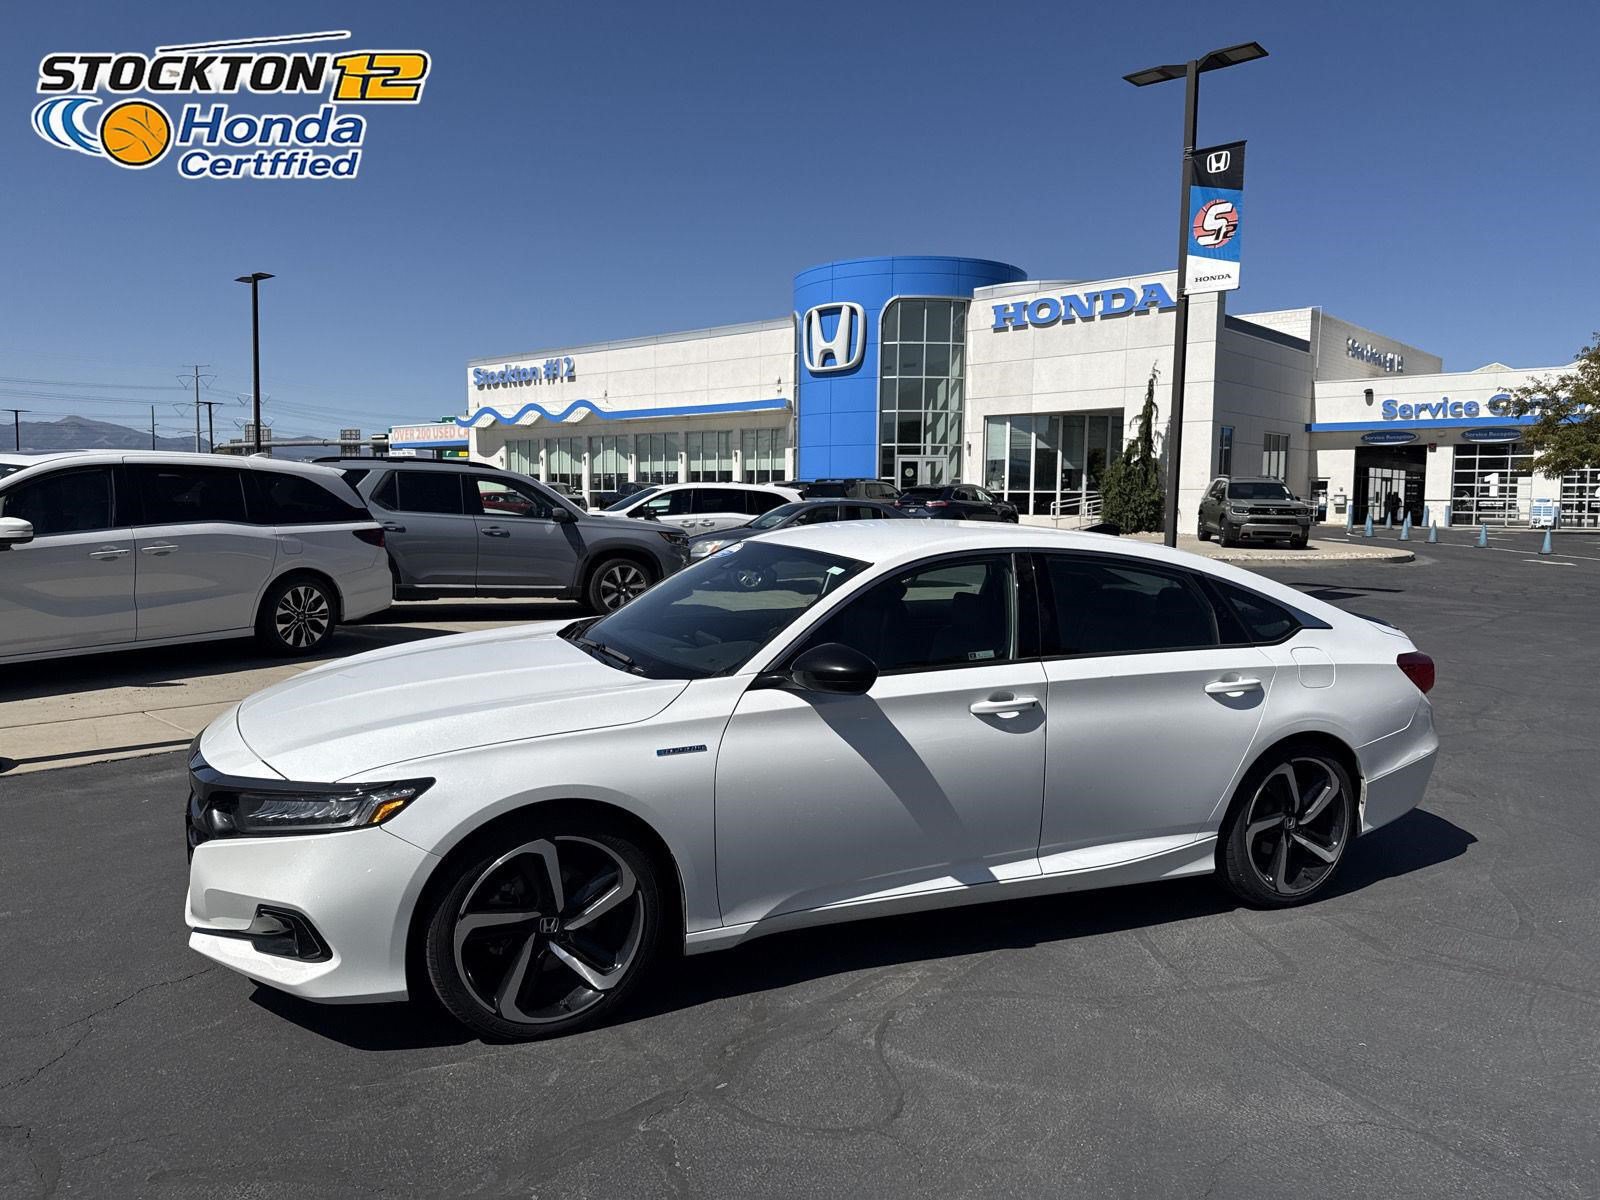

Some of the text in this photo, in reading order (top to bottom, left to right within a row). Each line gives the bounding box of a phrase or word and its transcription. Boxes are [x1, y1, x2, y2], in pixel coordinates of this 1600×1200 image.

[1195, 273, 1232, 283] HONDA
[991, 282, 1177, 329] HONDA
[473, 357, 576, 387] Stockton #12
[1381, 396, 1480, 421] Service
[394, 427, 415, 441] OVER
[416, 428, 432, 440] 200
[433, 425, 456, 440] USED
[1484, 472, 1499, 497] 1
